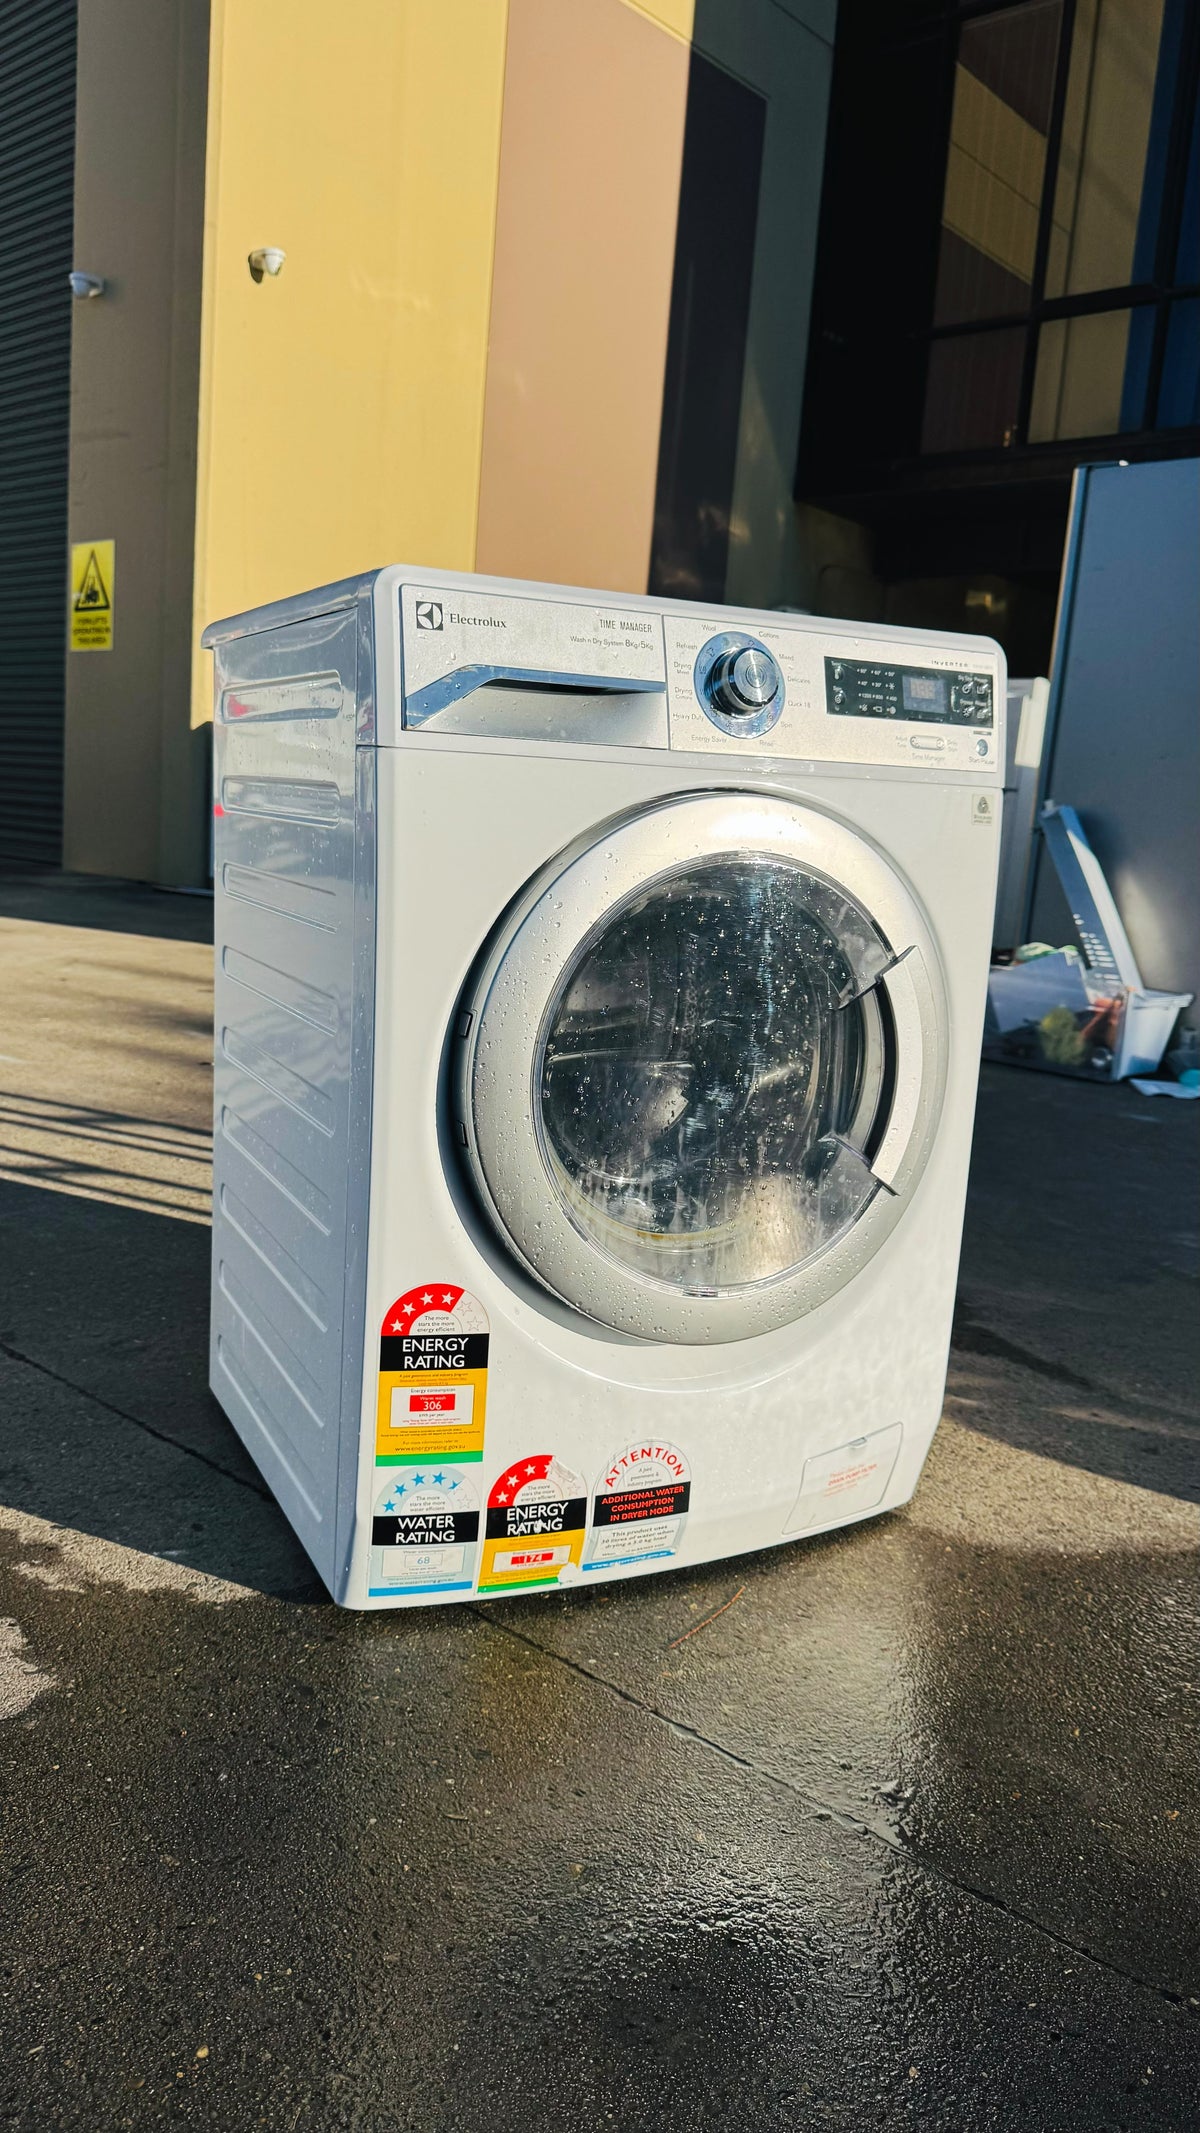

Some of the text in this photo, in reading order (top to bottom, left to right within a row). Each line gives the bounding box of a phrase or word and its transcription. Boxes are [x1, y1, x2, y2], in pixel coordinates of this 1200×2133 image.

[450, 613, 507, 628] Electrolux
[600, 619, 653, 633] TIME MANAGER
[701, 624, 717, 632] Wool
[676, 642, 698, 650] Refresh
[673, 661, 692, 671] Drying
[931, 659, 968, 667] INVERTER
[674, 687, 693, 696] Drying
[402, 1337, 469, 1352] ENERGY
[404, 1354, 465, 1369] RATING
[423, 1401, 442, 1411] 306
[605, 1447, 684, 1487] ATTENTION
[601, 1485, 684, 1505] ADDITIONAL WATER
[506, 1502, 569, 1521] ENERGY
[611, 1496, 675, 1513] CONSUMPTION
[610, 1505, 674, 1522] IN DRYER MODE
[397, 1515, 455, 1530] WATER
[395, 1530, 455, 1544] RATING
[417, 1556, 430, 1565] 68
